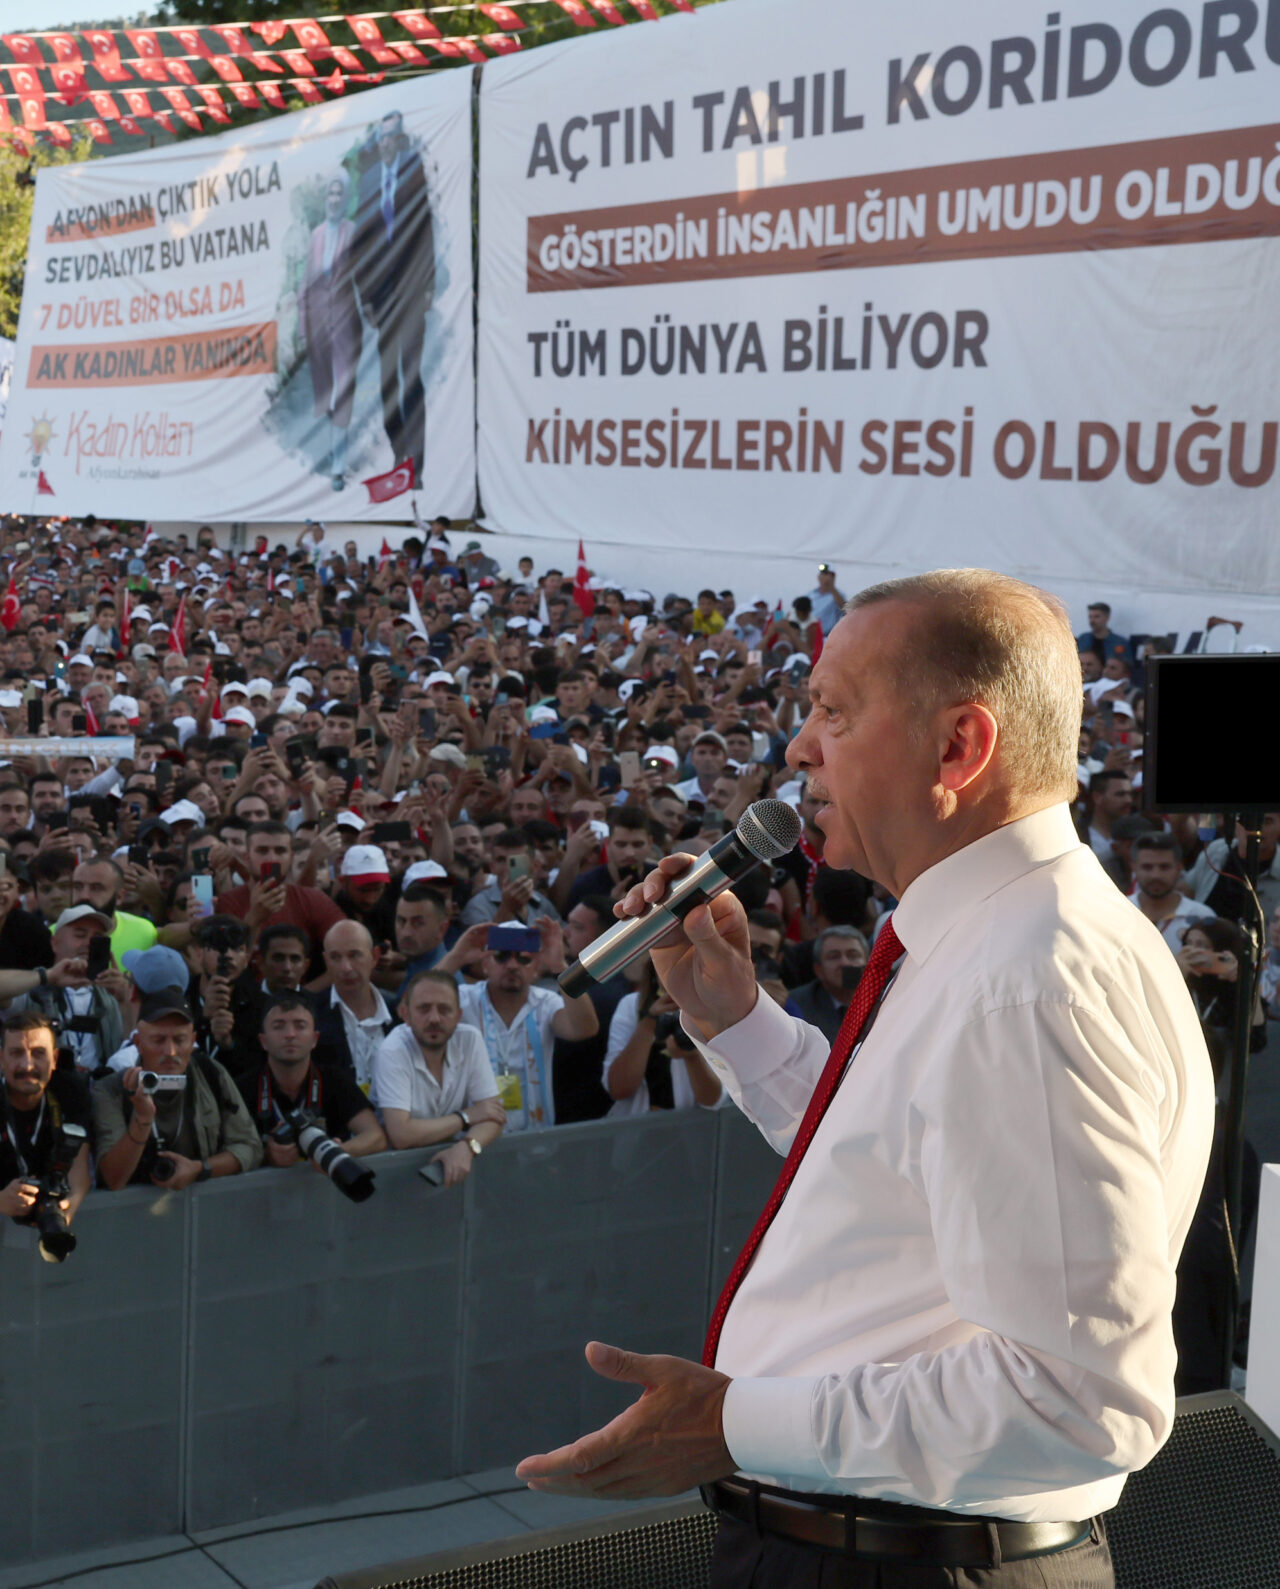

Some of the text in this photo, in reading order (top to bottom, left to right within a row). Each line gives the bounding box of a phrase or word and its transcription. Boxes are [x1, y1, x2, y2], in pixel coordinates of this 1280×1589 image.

[526, 99, 675, 183] AÇTIN
[692, 68, 864, 153] TAHIL
[49, 161, 282, 237] AFYON'DAN ÇIKTIK YOLA
[538, 211, 709, 272] GÖSTERDİN
[716, 187, 927, 256] İNSANLIĞIN
[937, 174, 1102, 236] UMUDU
[45, 219, 271, 285] SEVDALIYIZ BU VATANA
[39, 277, 246, 331] 7 DÜVEL BİR OLSA DA
[527, 300, 990, 378] TÜM DÜNYA BİLİYOR
[36, 331, 269, 381] AK KADINLAR YANINDA
[524, 404, 1279, 489] KİMSESİZLERİN SESİ OLDUĞU
